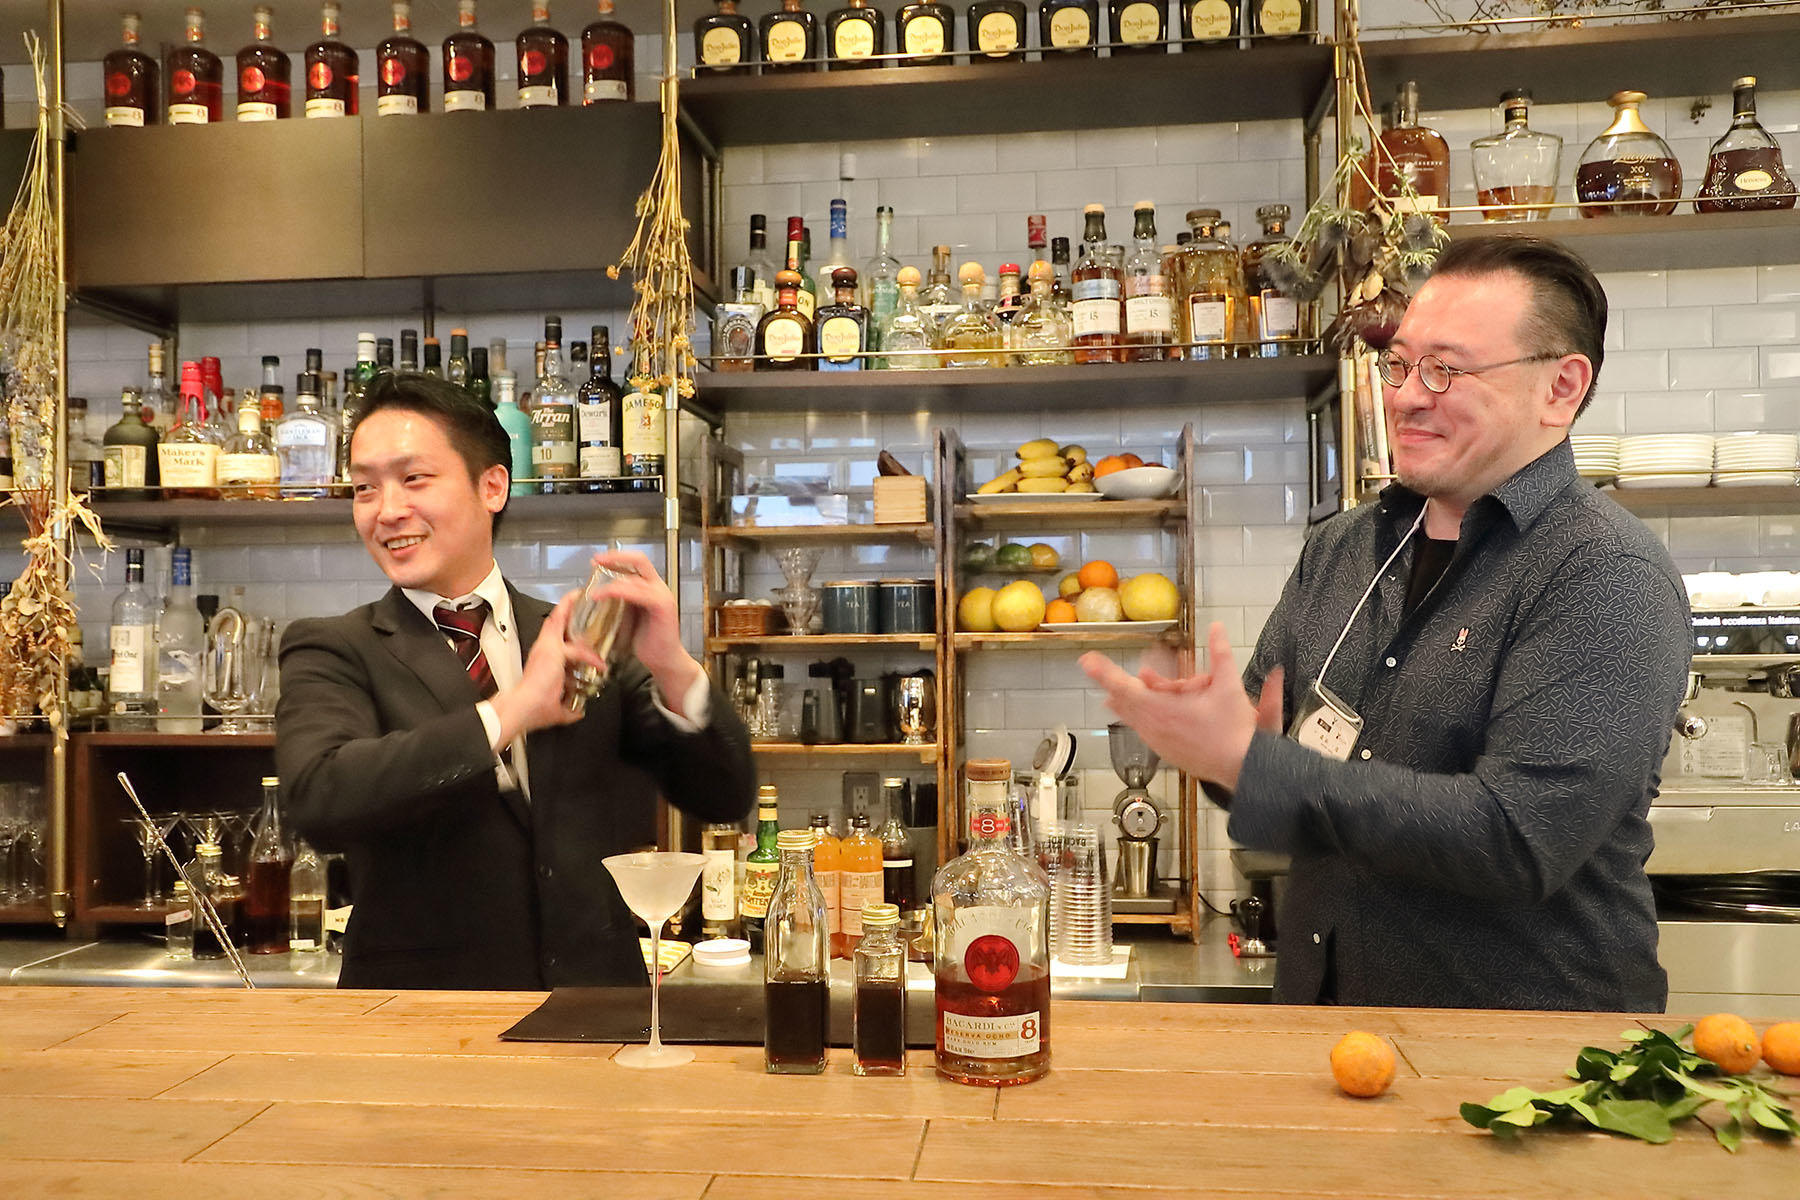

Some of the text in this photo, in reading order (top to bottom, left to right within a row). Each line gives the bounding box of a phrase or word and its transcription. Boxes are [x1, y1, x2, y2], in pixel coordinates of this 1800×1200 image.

[625, 398, 664, 412] JAMESO
[531, 409, 570, 424] Arran
[541, 448, 552, 460] 10
[981, 818, 995, 832] 8
[946, 1016, 995, 1030] BACARDI
[1021, 1019, 1037, 1040] 8
[946, 1026, 980, 1039] RESERVA
